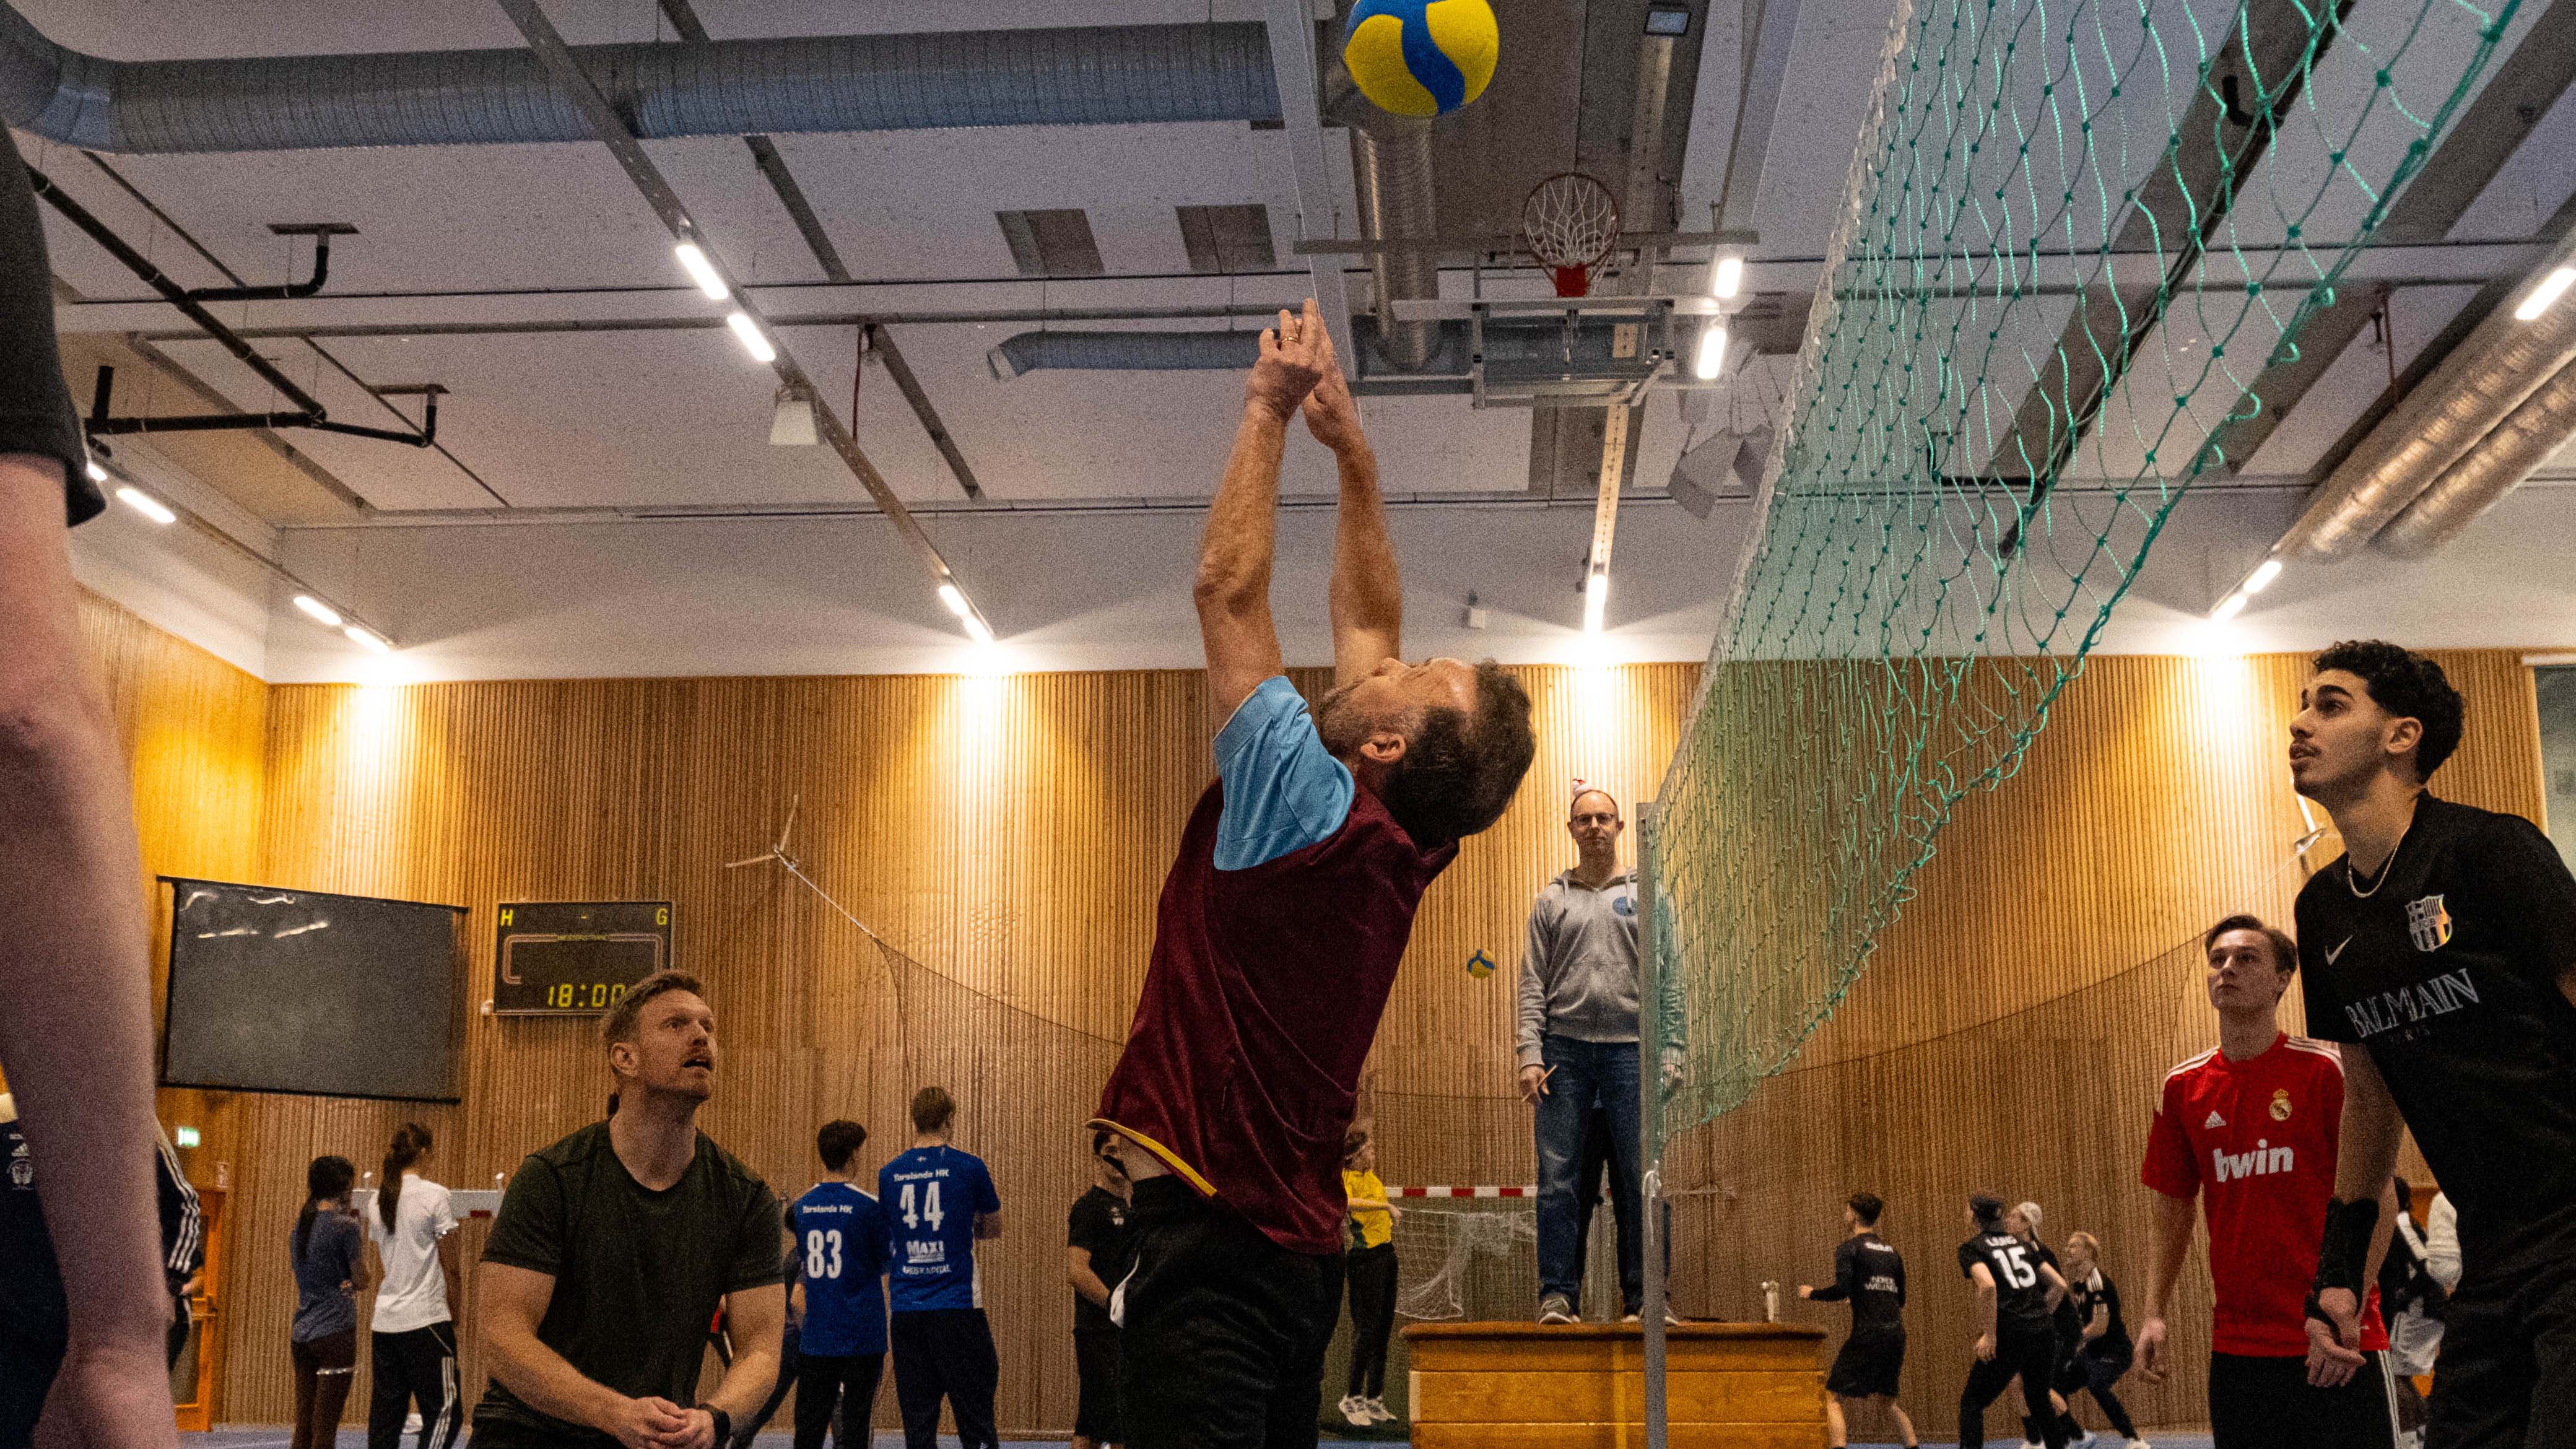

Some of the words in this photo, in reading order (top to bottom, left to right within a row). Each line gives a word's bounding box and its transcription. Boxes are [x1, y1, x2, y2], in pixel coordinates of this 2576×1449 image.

[500, 908, 513, 926] H
[656, 908, 668, 925] G
[2345, 967, 2479, 1038] BALMAIN
[2213, 1139, 2294, 1183] bwin
[900, 1181, 945, 1232] 44
[807, 1229, 842, 1279] 83
[1992, 1245, 2036, 1289] 15
